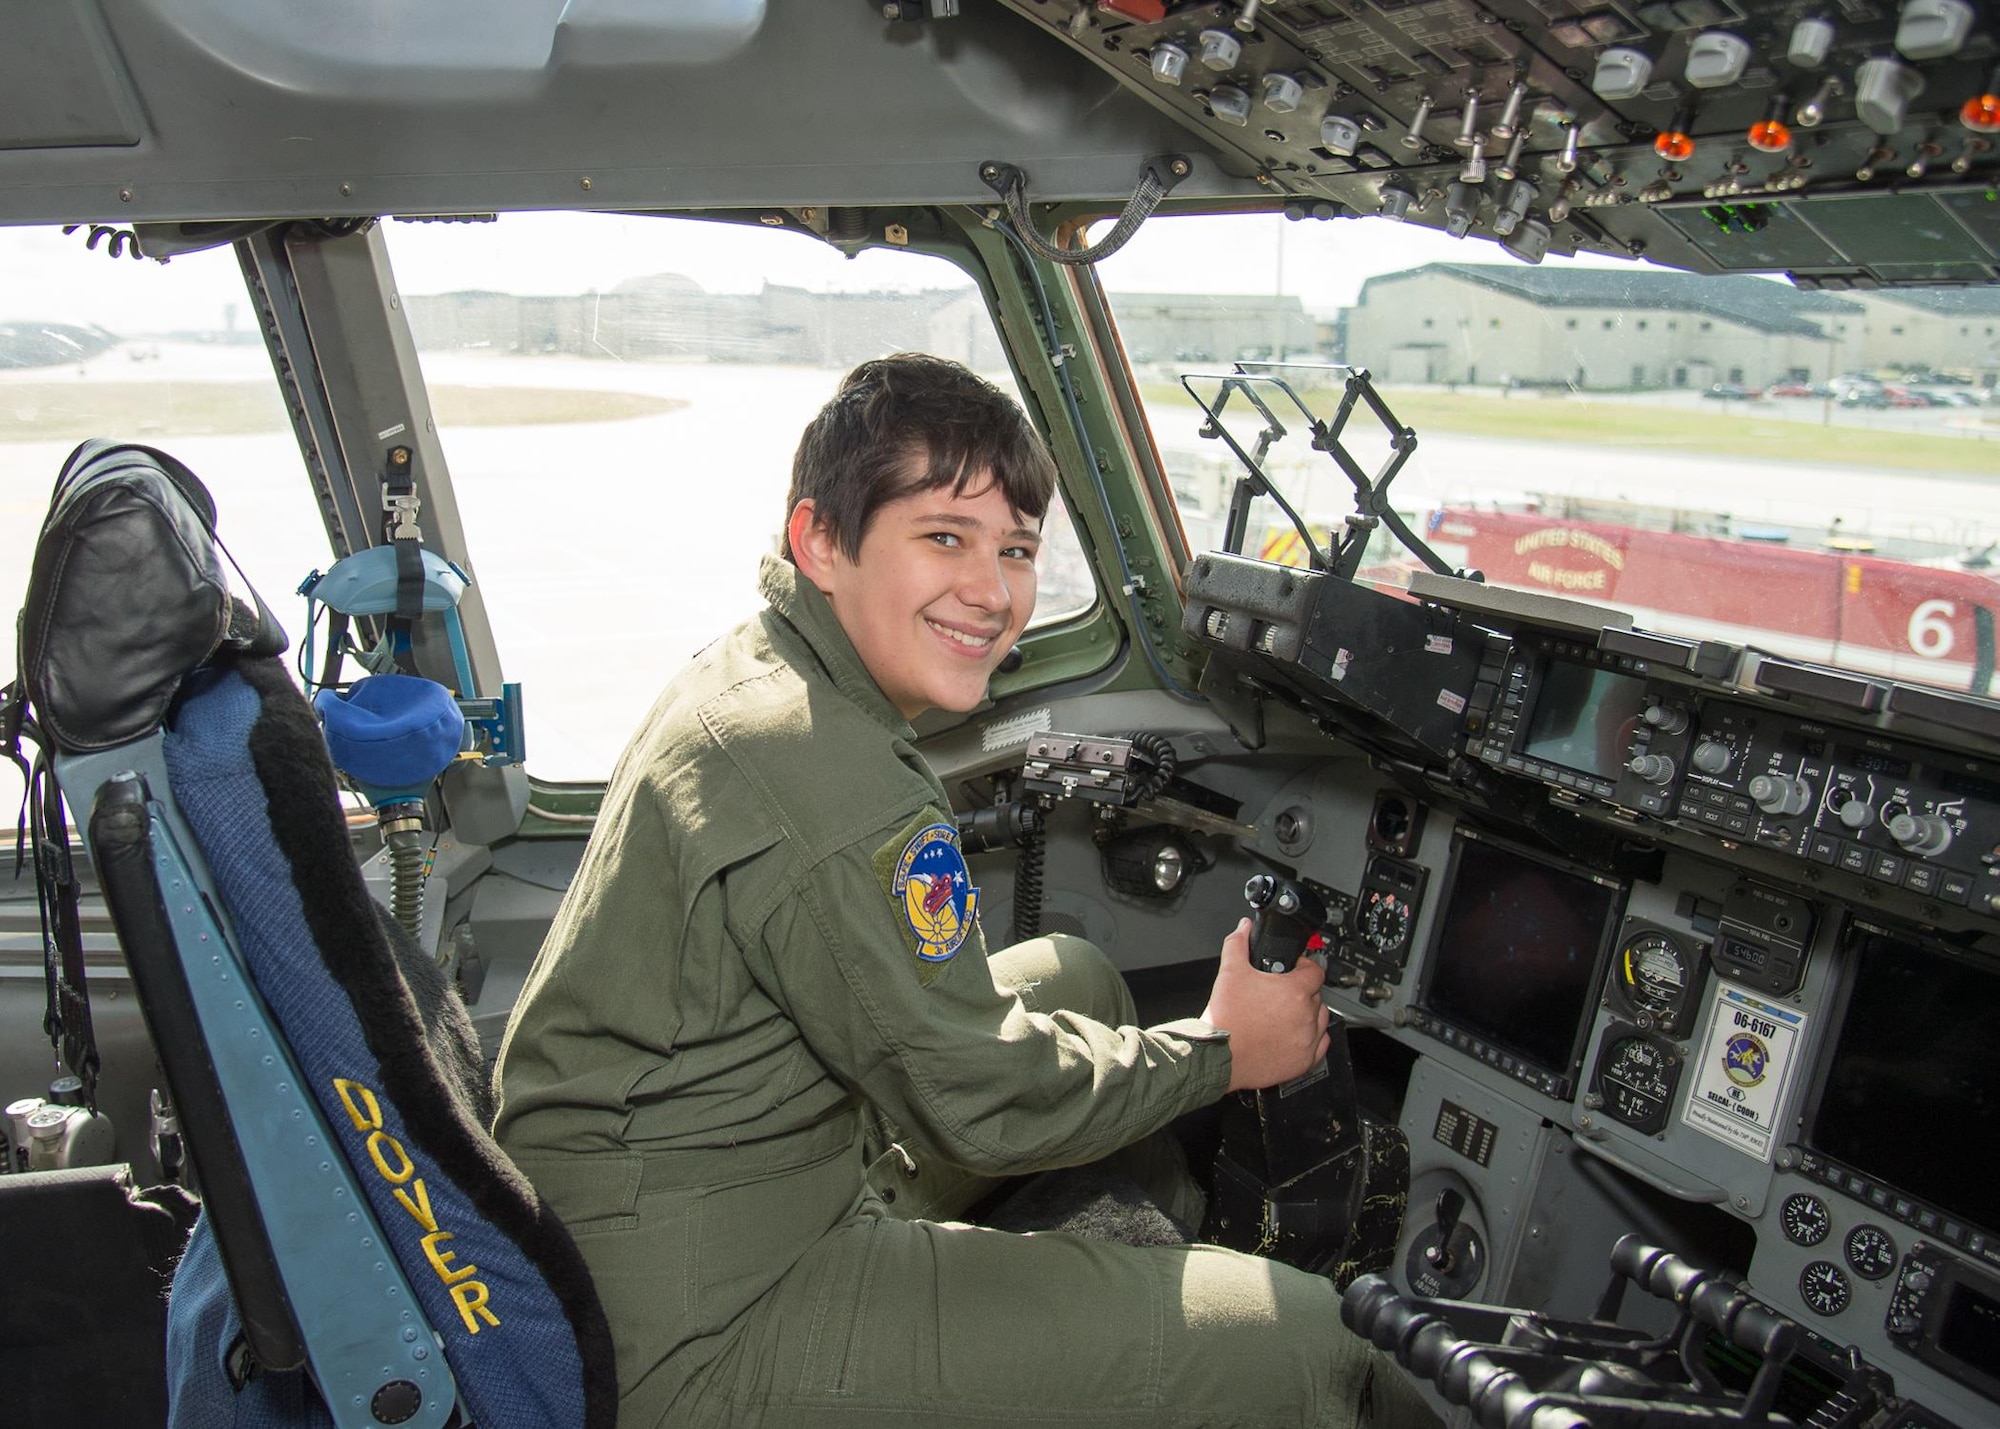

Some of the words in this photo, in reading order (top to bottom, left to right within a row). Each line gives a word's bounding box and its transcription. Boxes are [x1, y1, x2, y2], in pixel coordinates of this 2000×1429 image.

[1514, 527, 1570, 555] UNITED
[1569, 528, 1625, 571] STATES
[1528, 561, 1553, 584] AIR
[1554, 568, 1606, 589] FORCE
[1908, 599, 1954, 658] 6
[897, 861, 911, 891] SAFE
[910, 831, 931, 856] SWIFT
[933, 829, 952, 842] SURE
[1734, 945, 1765, 965] 54600
[1734, 1011, 1777, 1039] 06-6167
[332, 1077, 501, 1335] DOVER
[1413, 1280, 1440, 1298] ADJUST
[1421, 1273, 1440, 1290] PEDAL
